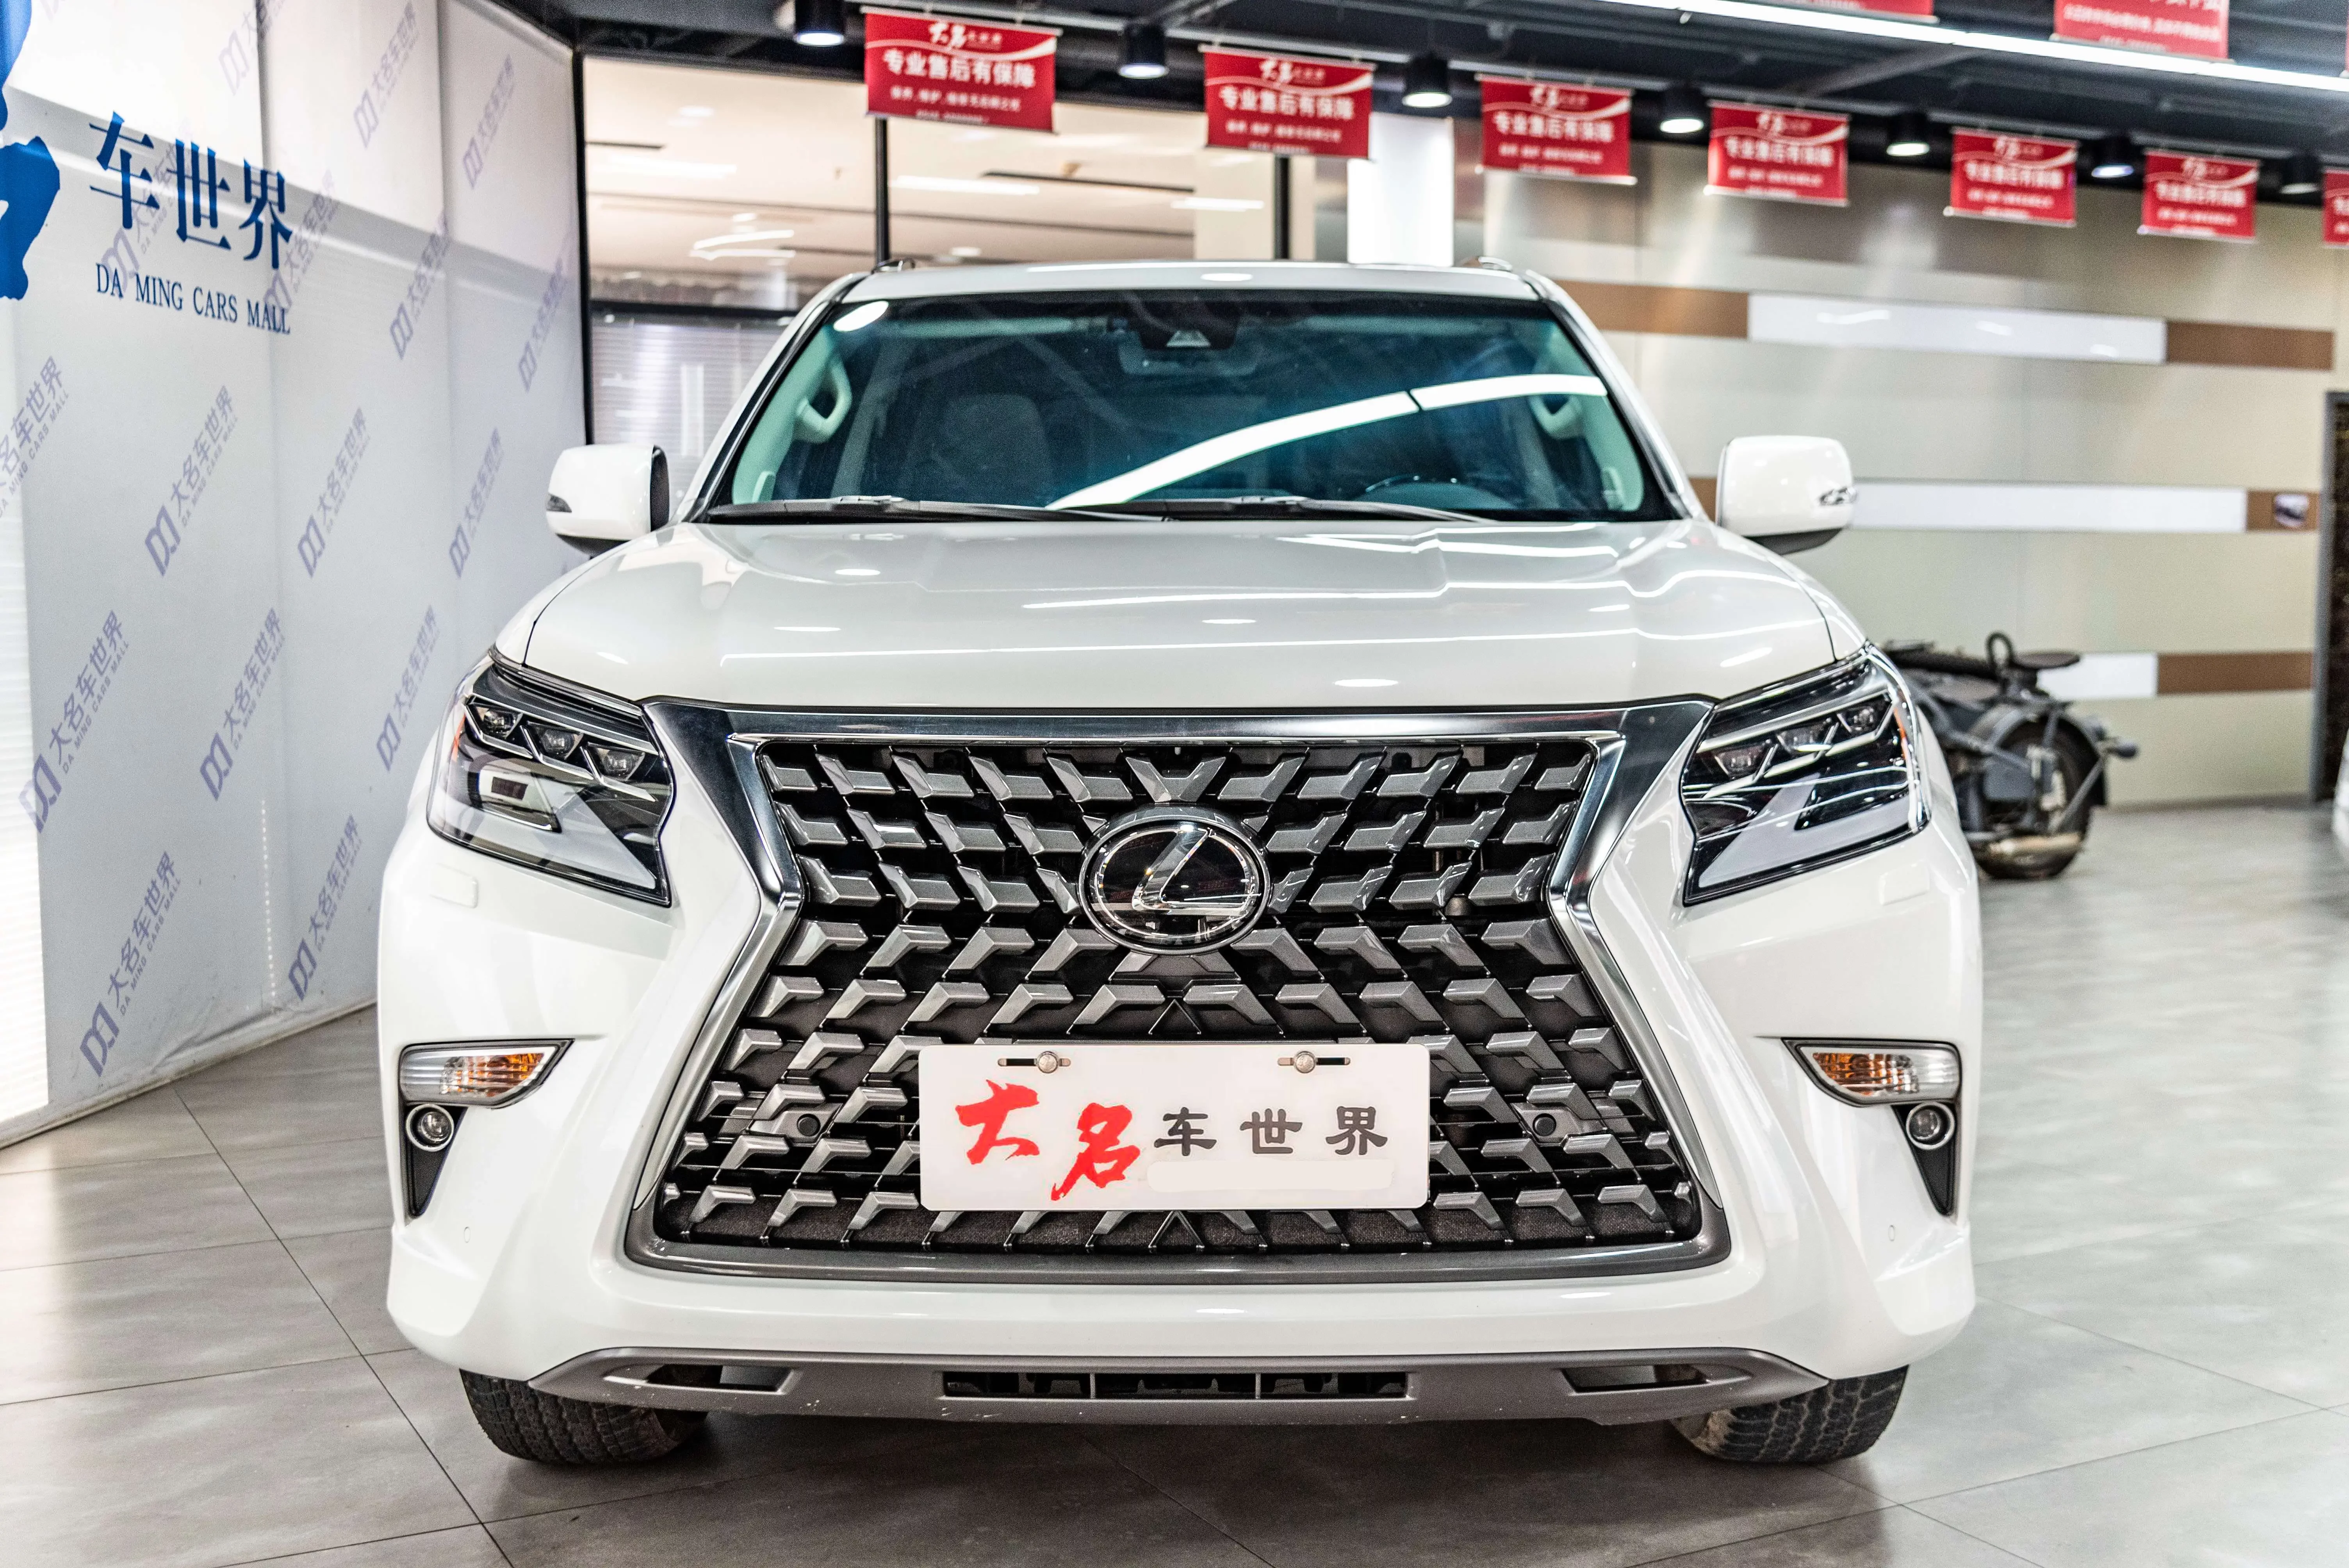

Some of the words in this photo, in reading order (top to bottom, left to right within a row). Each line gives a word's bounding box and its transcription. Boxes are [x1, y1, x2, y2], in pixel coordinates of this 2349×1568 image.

[883, 48, 1034, 88] 专业售后有保障
[89, 110, 292, 269] 车世界
[96, 262, 124, 299] DA
[135, 271, 183, 311] MING
[193, 286, 238, 323] CARS
[247, 298, 291, 335] MALL
[0, 356, 62, 486] 名车世界
[171, 385, 233, 518] 大名车世界
[50, 609, 122, 765] 大名车世界
[223, 608, 281, 741] 大名车世界
[108, 851, 175, 1008] 大名车世界
